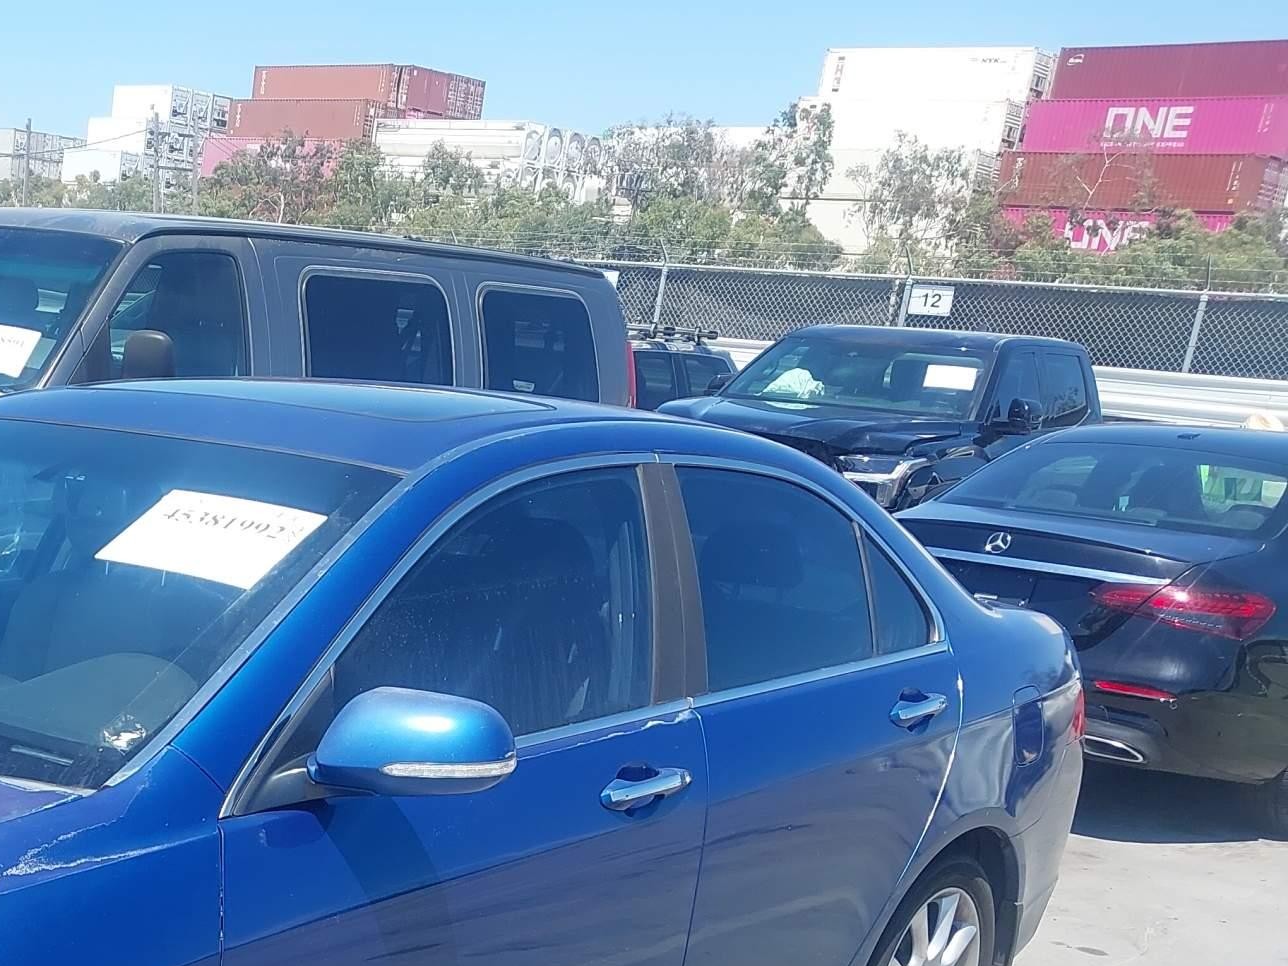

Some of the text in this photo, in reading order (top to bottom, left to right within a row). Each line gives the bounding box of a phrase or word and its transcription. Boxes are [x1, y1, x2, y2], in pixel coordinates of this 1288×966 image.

[1102, 105, 1195, 139] ONE
[922, 292, 942, 308] 12
[163, 508, 285, 540] 45381992
